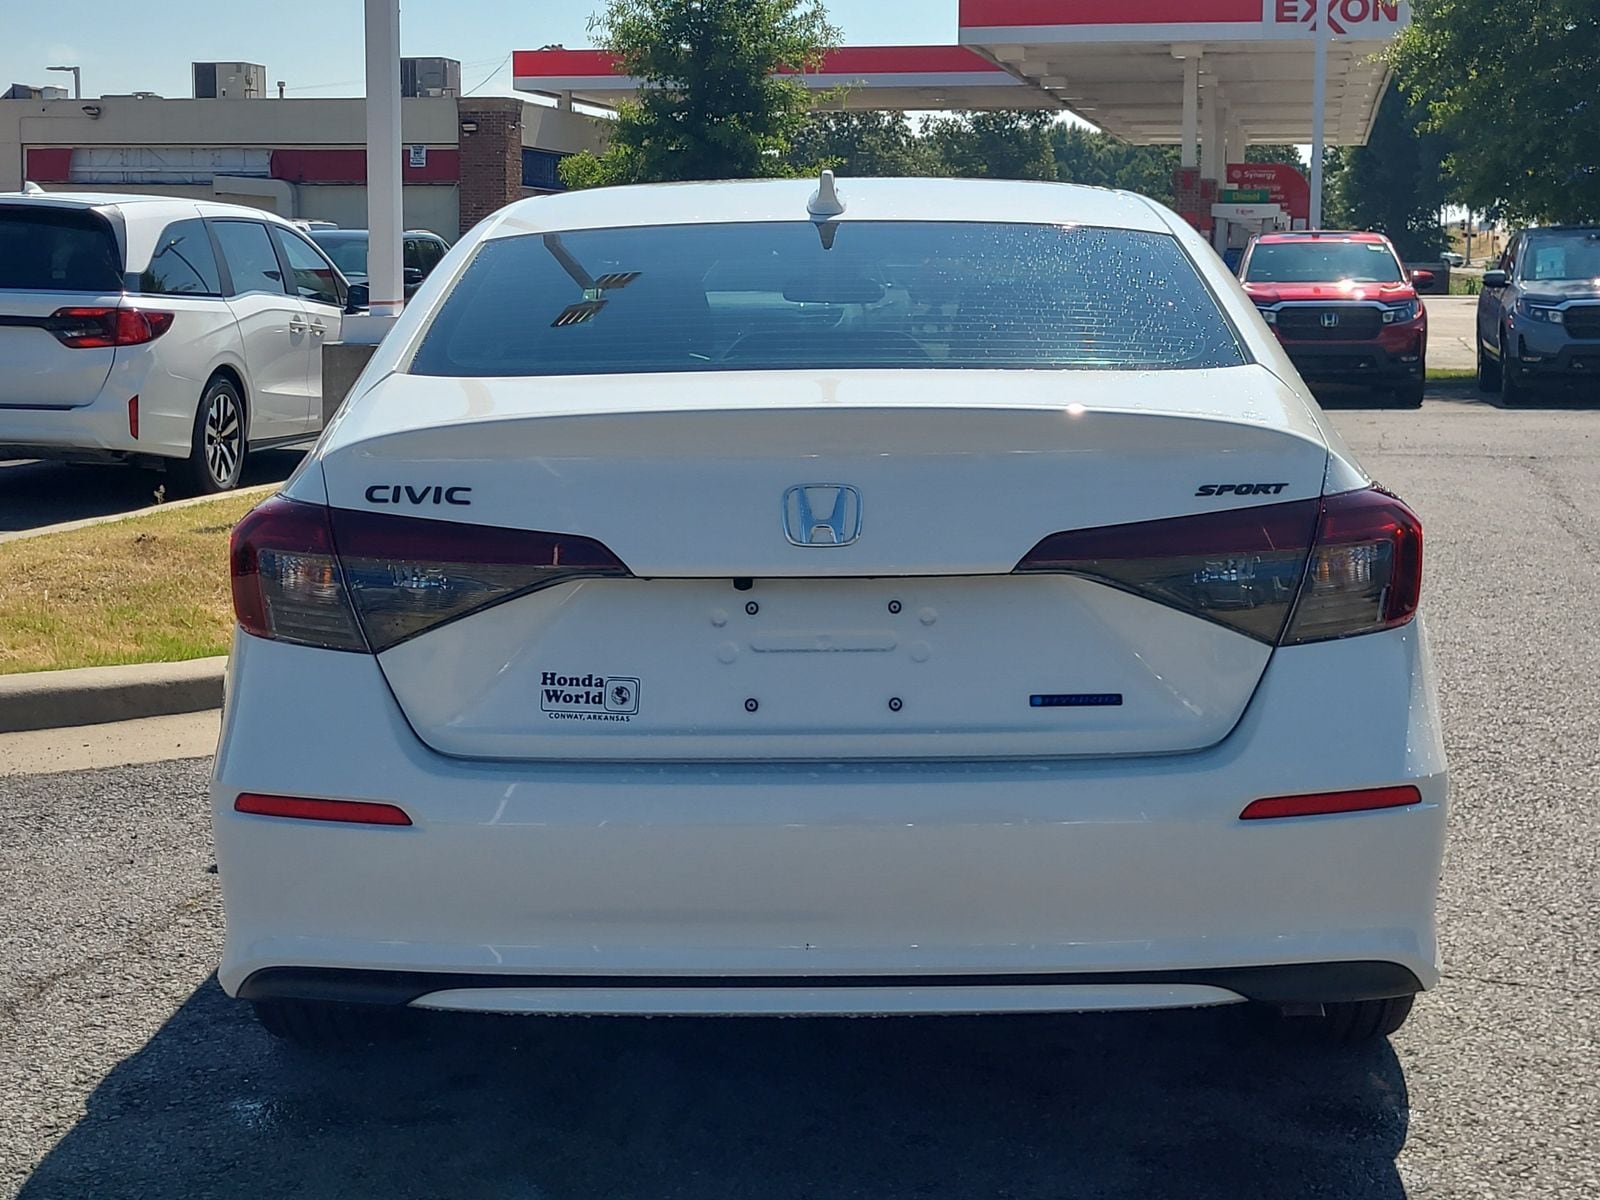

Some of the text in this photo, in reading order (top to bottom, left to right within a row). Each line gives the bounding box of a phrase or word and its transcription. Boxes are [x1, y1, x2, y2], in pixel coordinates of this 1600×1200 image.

[1243, 170, 1276, 180] Synergy
[365, 485, 472, 505] CIVIC
[1194, 483, 1290, 497] SPORT
[541, 672, 605, 688] Honda
[544, 689, 604, 705] World
[548, 712, 630, 722] CONWAY, ARKANSAS
